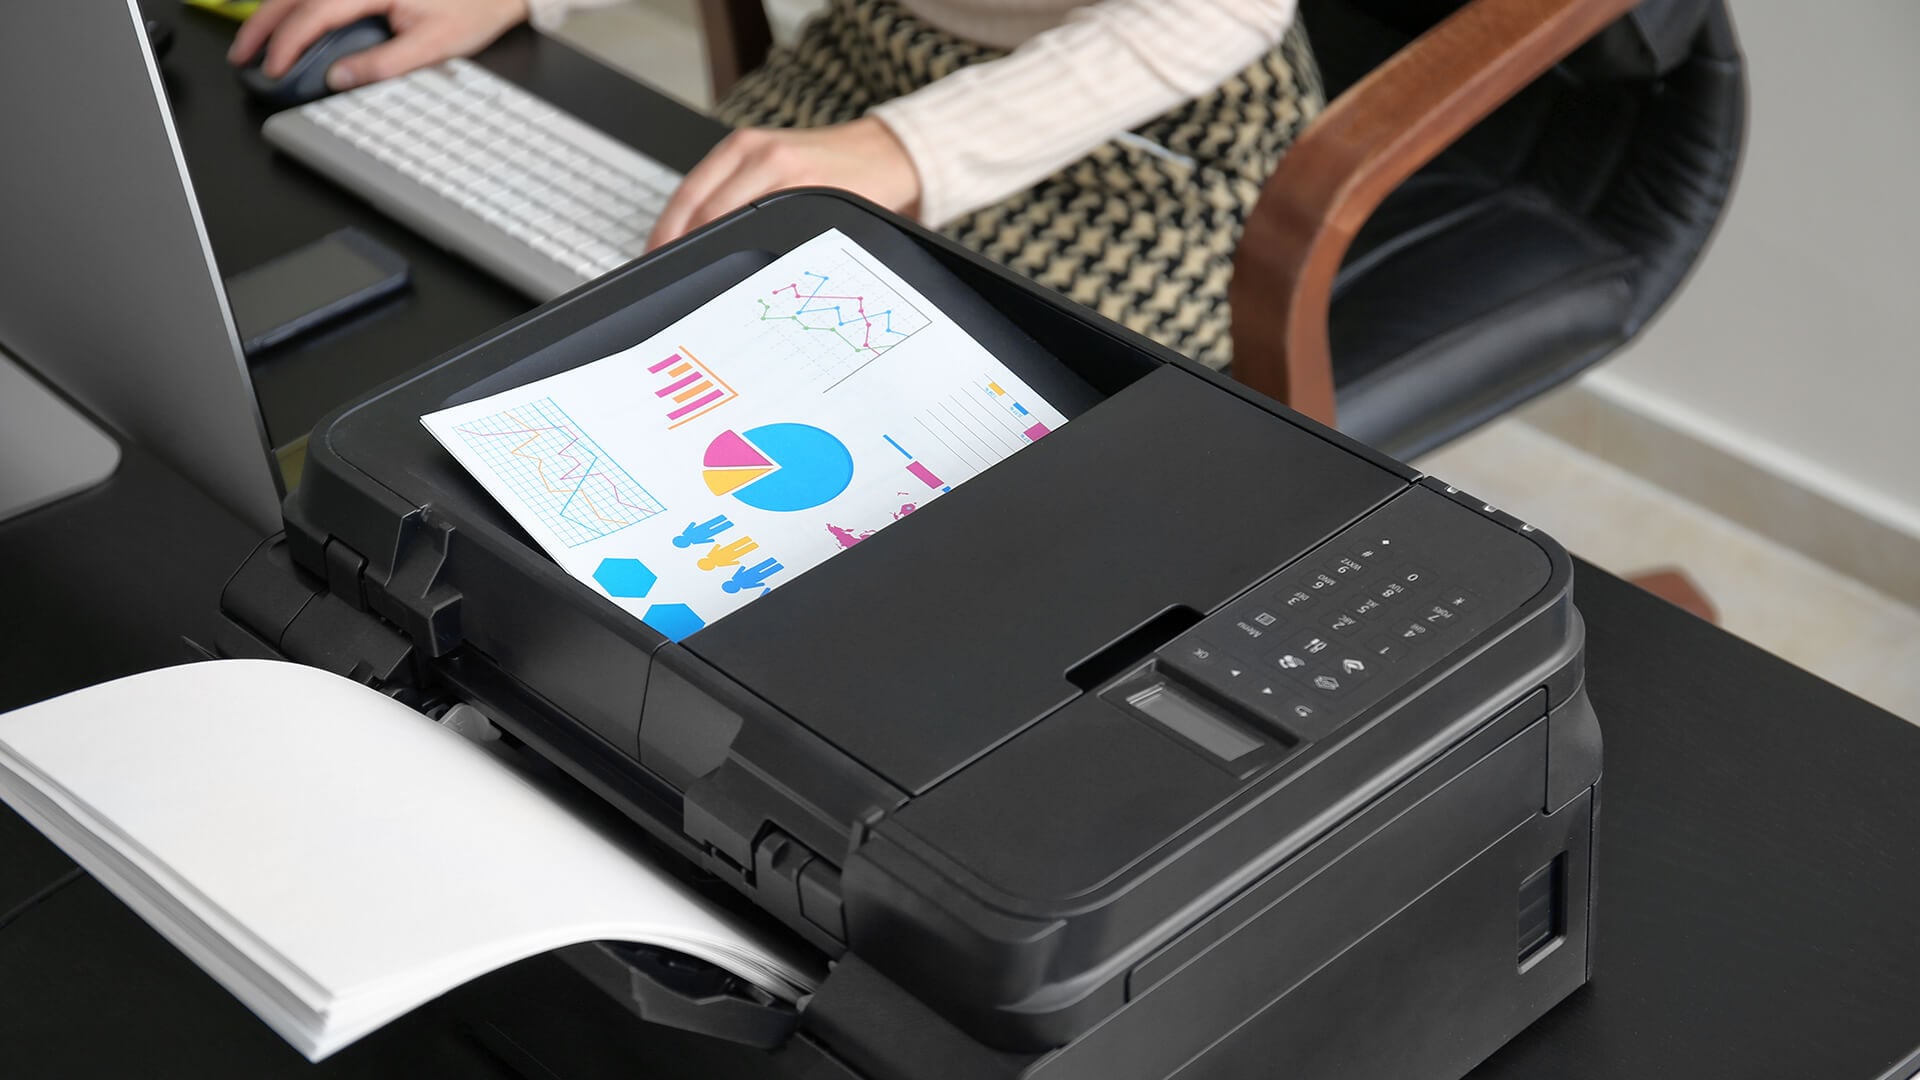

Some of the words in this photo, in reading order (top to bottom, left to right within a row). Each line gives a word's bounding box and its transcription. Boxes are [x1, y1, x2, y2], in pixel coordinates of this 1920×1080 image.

[1341, 558, 1362, 571] WXYZ
[1337, 566, 1350, 574] 9
[1317, 574, 1337, 586] MNO
[1312, 581, 1325, 589] 6
[1387, 583, 1404, 593] TUV
[1382, 589, 1395, 597] 8
[1287, 597, 1301, 606] 3
[1356, 605, 1370, 614] 5
[1427, 614, 1441, 622] 7
[1332, 621, 1345, 629] 2
[1237, 622, 1262, 638] Menu
[1193, 648, 1209, 659] OK
[1379, 646, 1391, 655] 1
